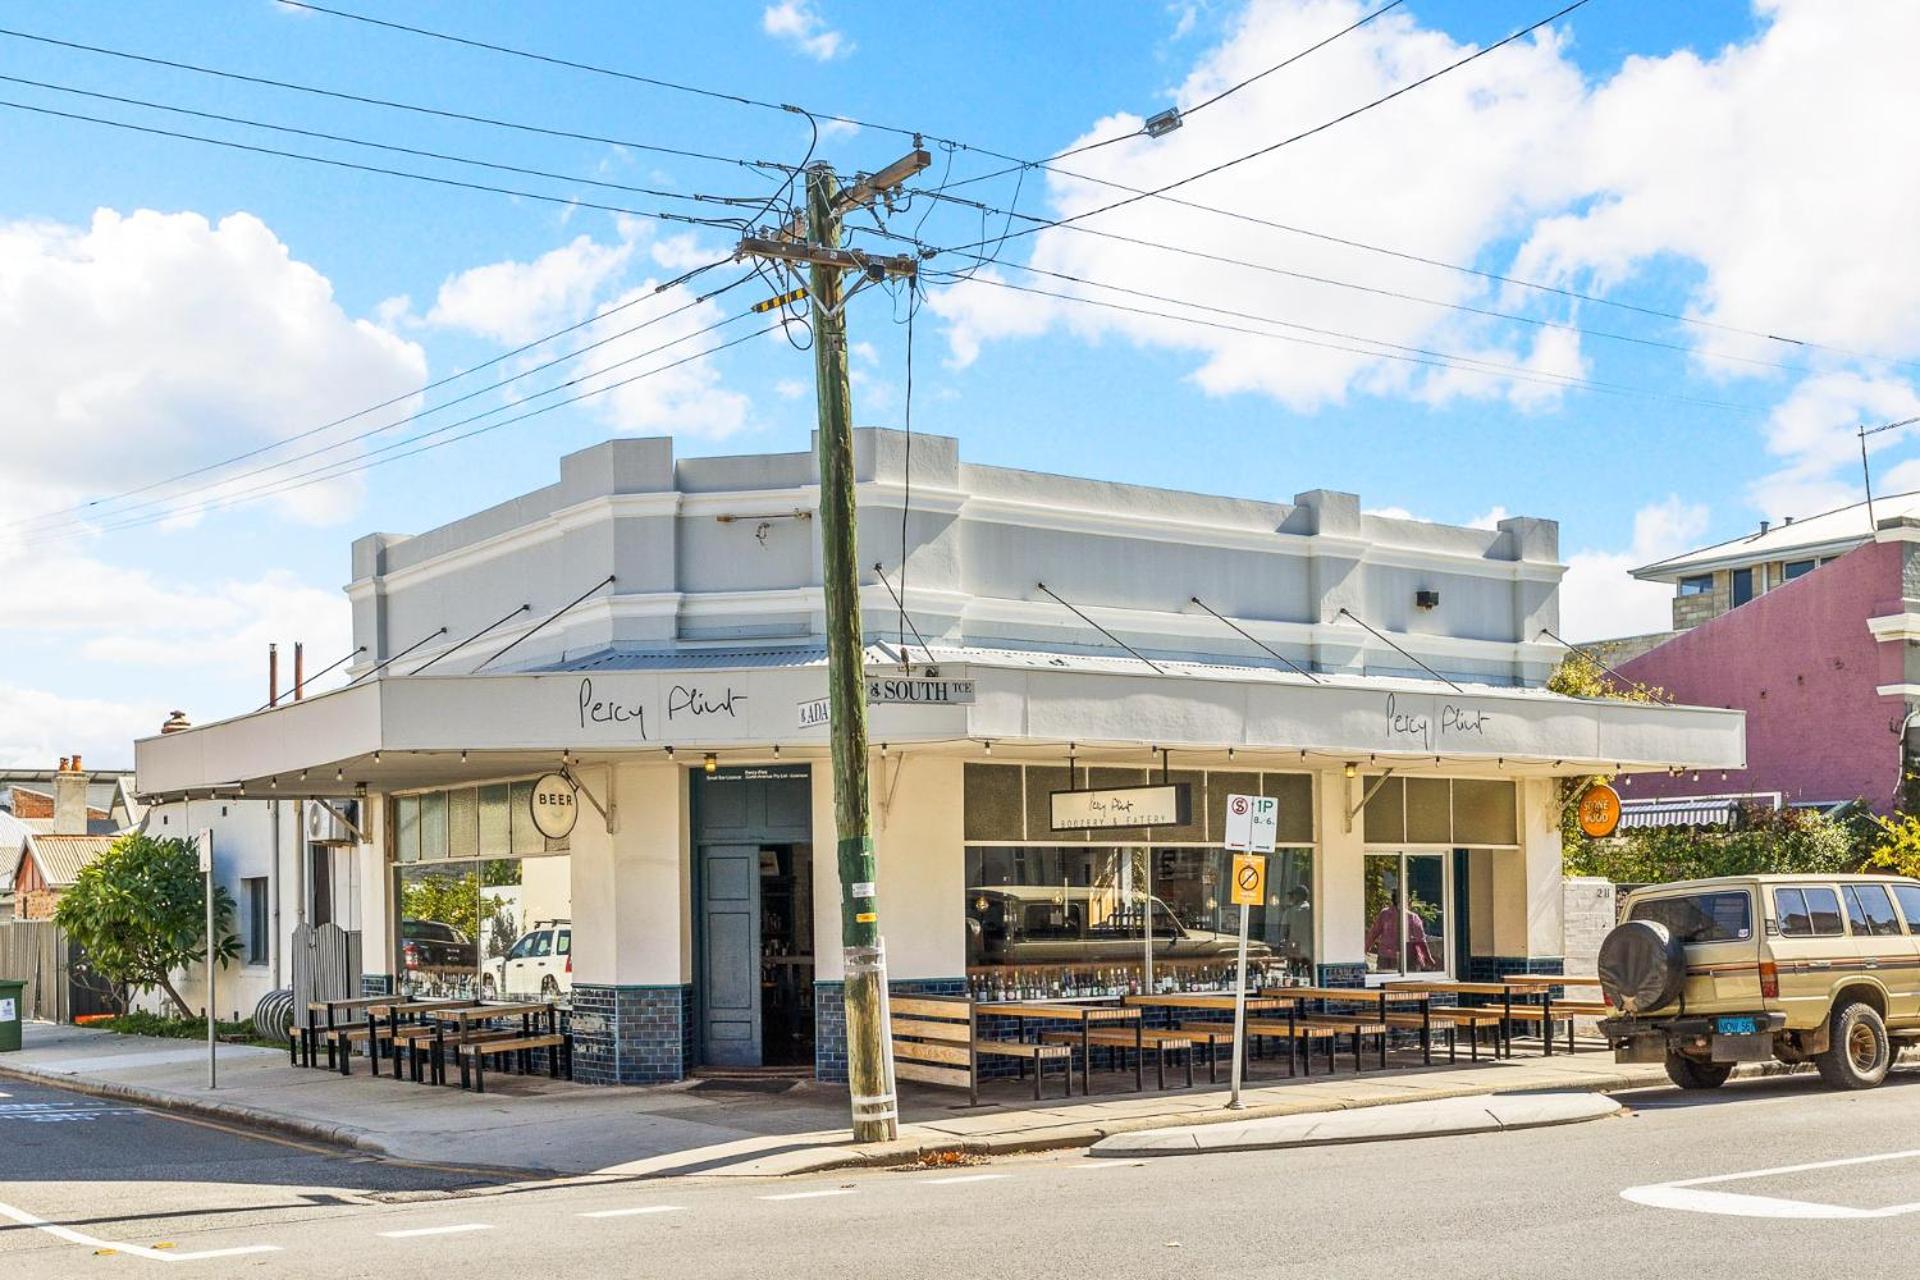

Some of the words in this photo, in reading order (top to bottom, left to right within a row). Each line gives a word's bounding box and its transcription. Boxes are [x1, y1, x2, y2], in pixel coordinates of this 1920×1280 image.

[884, 680, 948, 701] SOUTH
[579, 677, 647, 741] Percy
[669, 685, 749, 721] Flint
[1386, 692, 1429, 751] Percy
[1442, 704, 1492, 736] Flint
[539, 793, 573, 806] BEER
[1257, 799, 1274, 813] 1P
